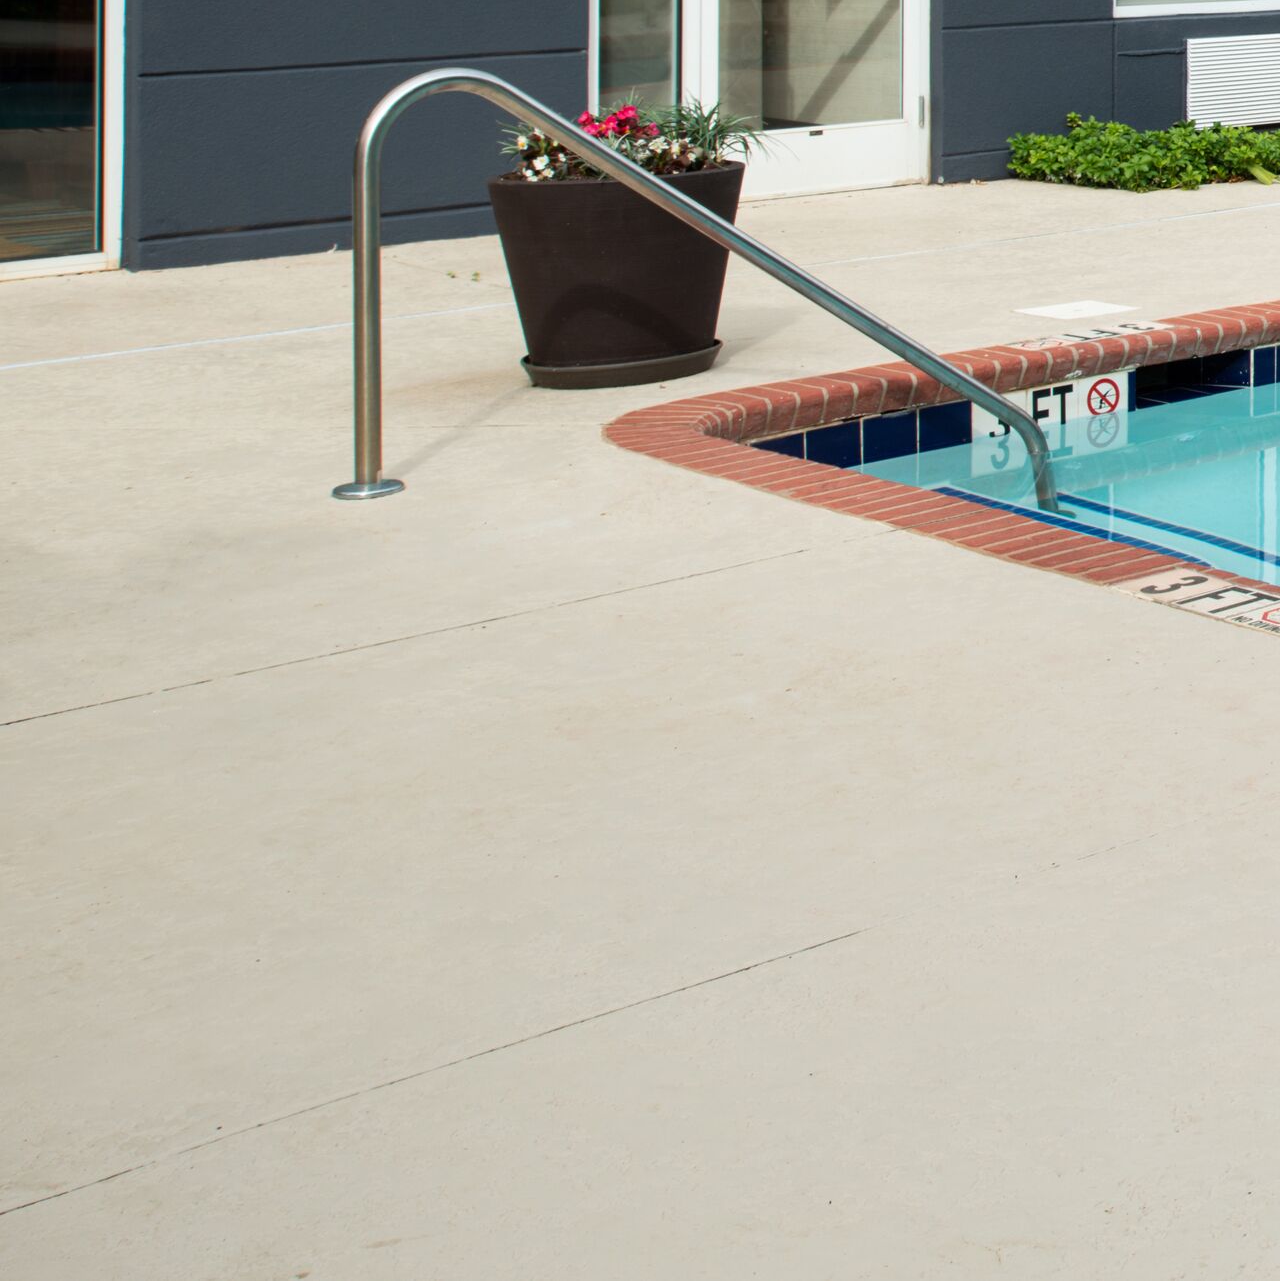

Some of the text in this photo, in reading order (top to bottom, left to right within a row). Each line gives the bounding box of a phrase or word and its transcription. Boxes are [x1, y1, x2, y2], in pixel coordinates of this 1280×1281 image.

[1032, 384, 1073, 425] FT
[1140, 575, 1208, 595] 3
[1231, 615, 1253, 623] NO
